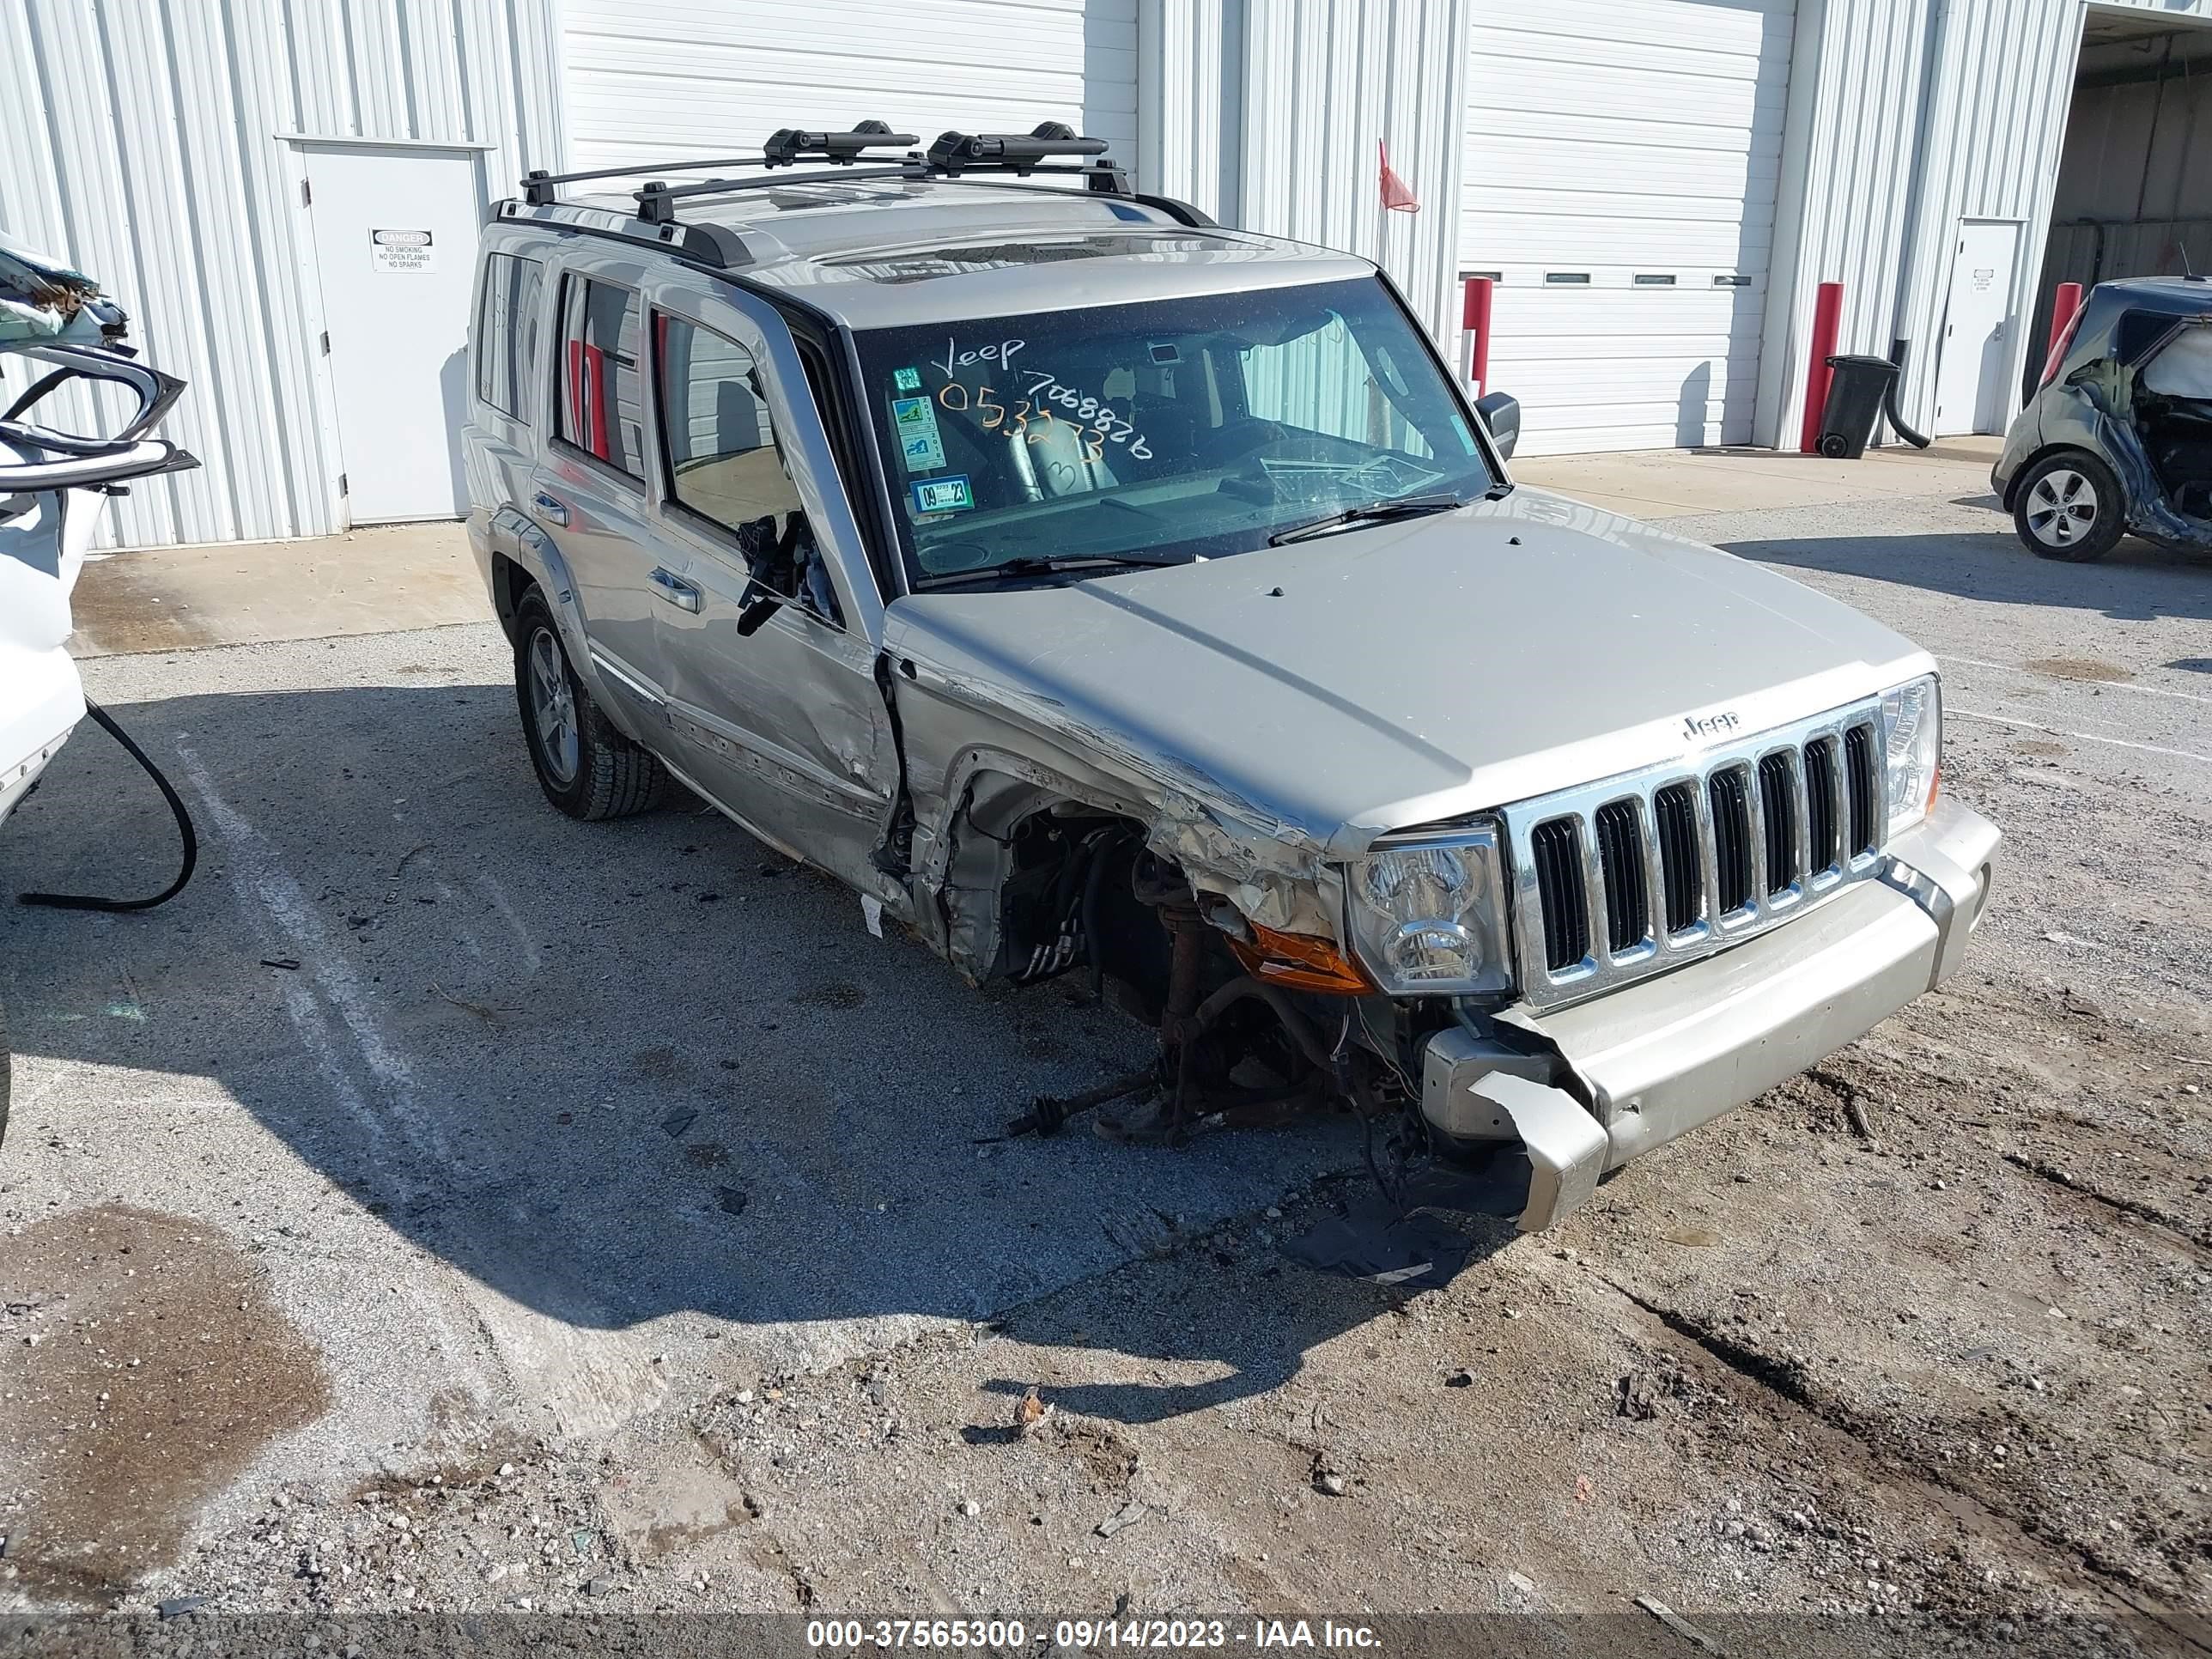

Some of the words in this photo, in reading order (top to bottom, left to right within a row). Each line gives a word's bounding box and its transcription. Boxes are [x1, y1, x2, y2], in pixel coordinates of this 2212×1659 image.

[381, 234, 424, 242] DANGER
[930, 337, 1026, 380] Jeep
[922, 398, 932, 422] 2017
[923, 487, 937, 507] 09
[951, 483, 965, 503] 23
[1682, 711, 1739, 742] Jeep
